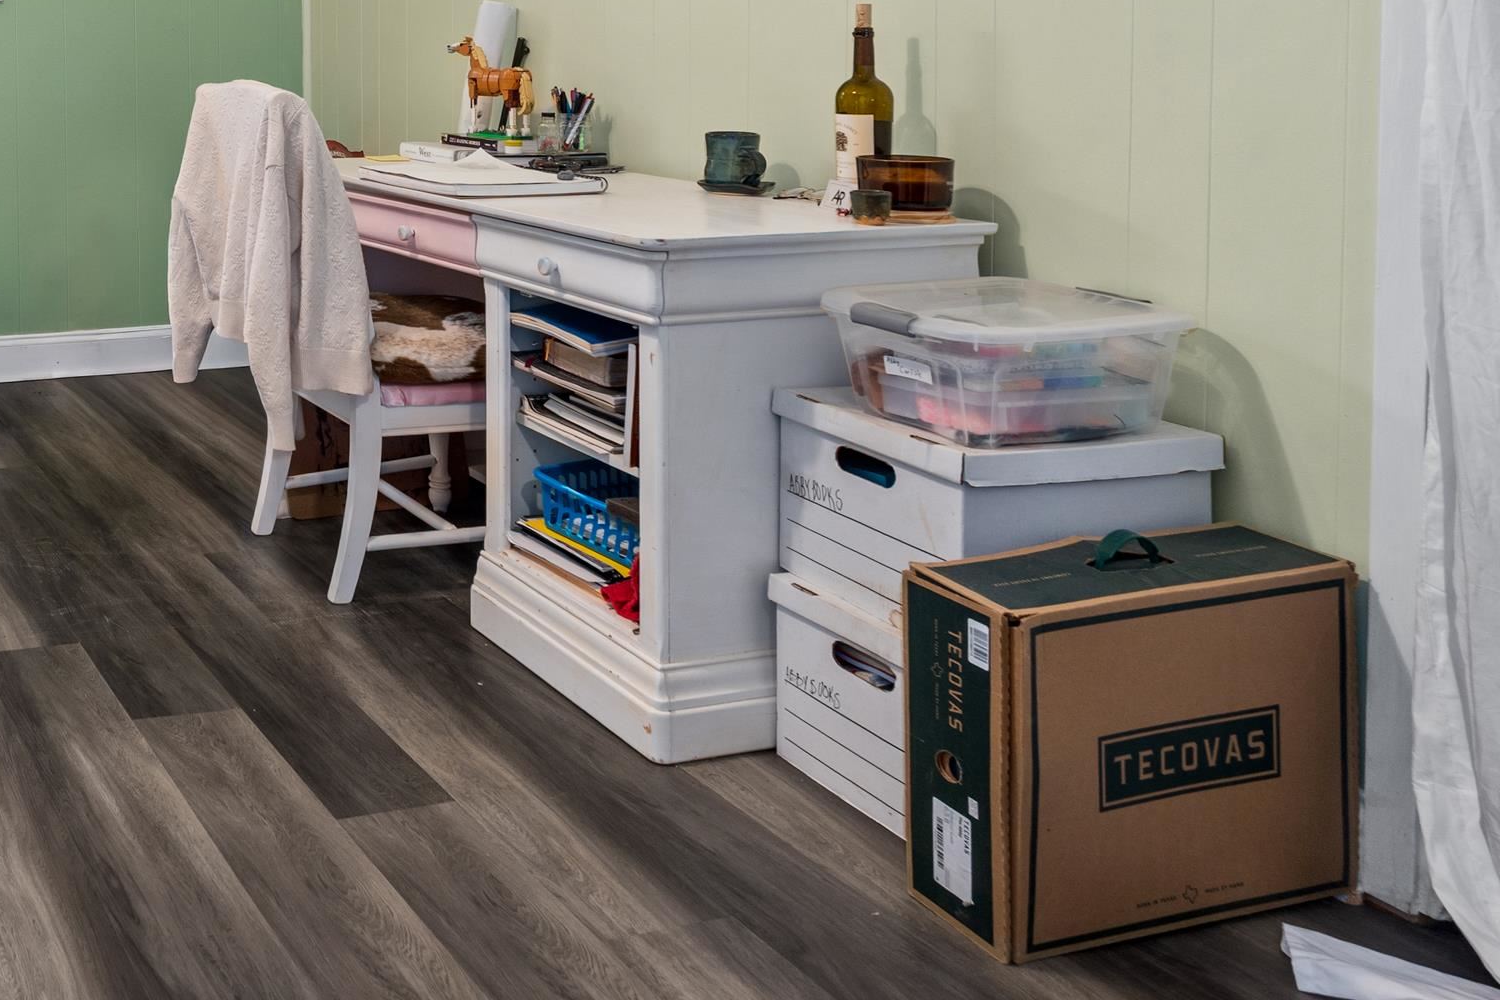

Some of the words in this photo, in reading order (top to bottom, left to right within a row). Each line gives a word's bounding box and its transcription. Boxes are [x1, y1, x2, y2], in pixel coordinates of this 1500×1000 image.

[789, 473, 811, 499] ABBY
[812, 480, 844, 512] BOOKS
[947, 630, 964, 733] TECOVAS
[1113, 729, 1266, 786] TECOVAS
[963, 819, 971, 856] TECOVAS
